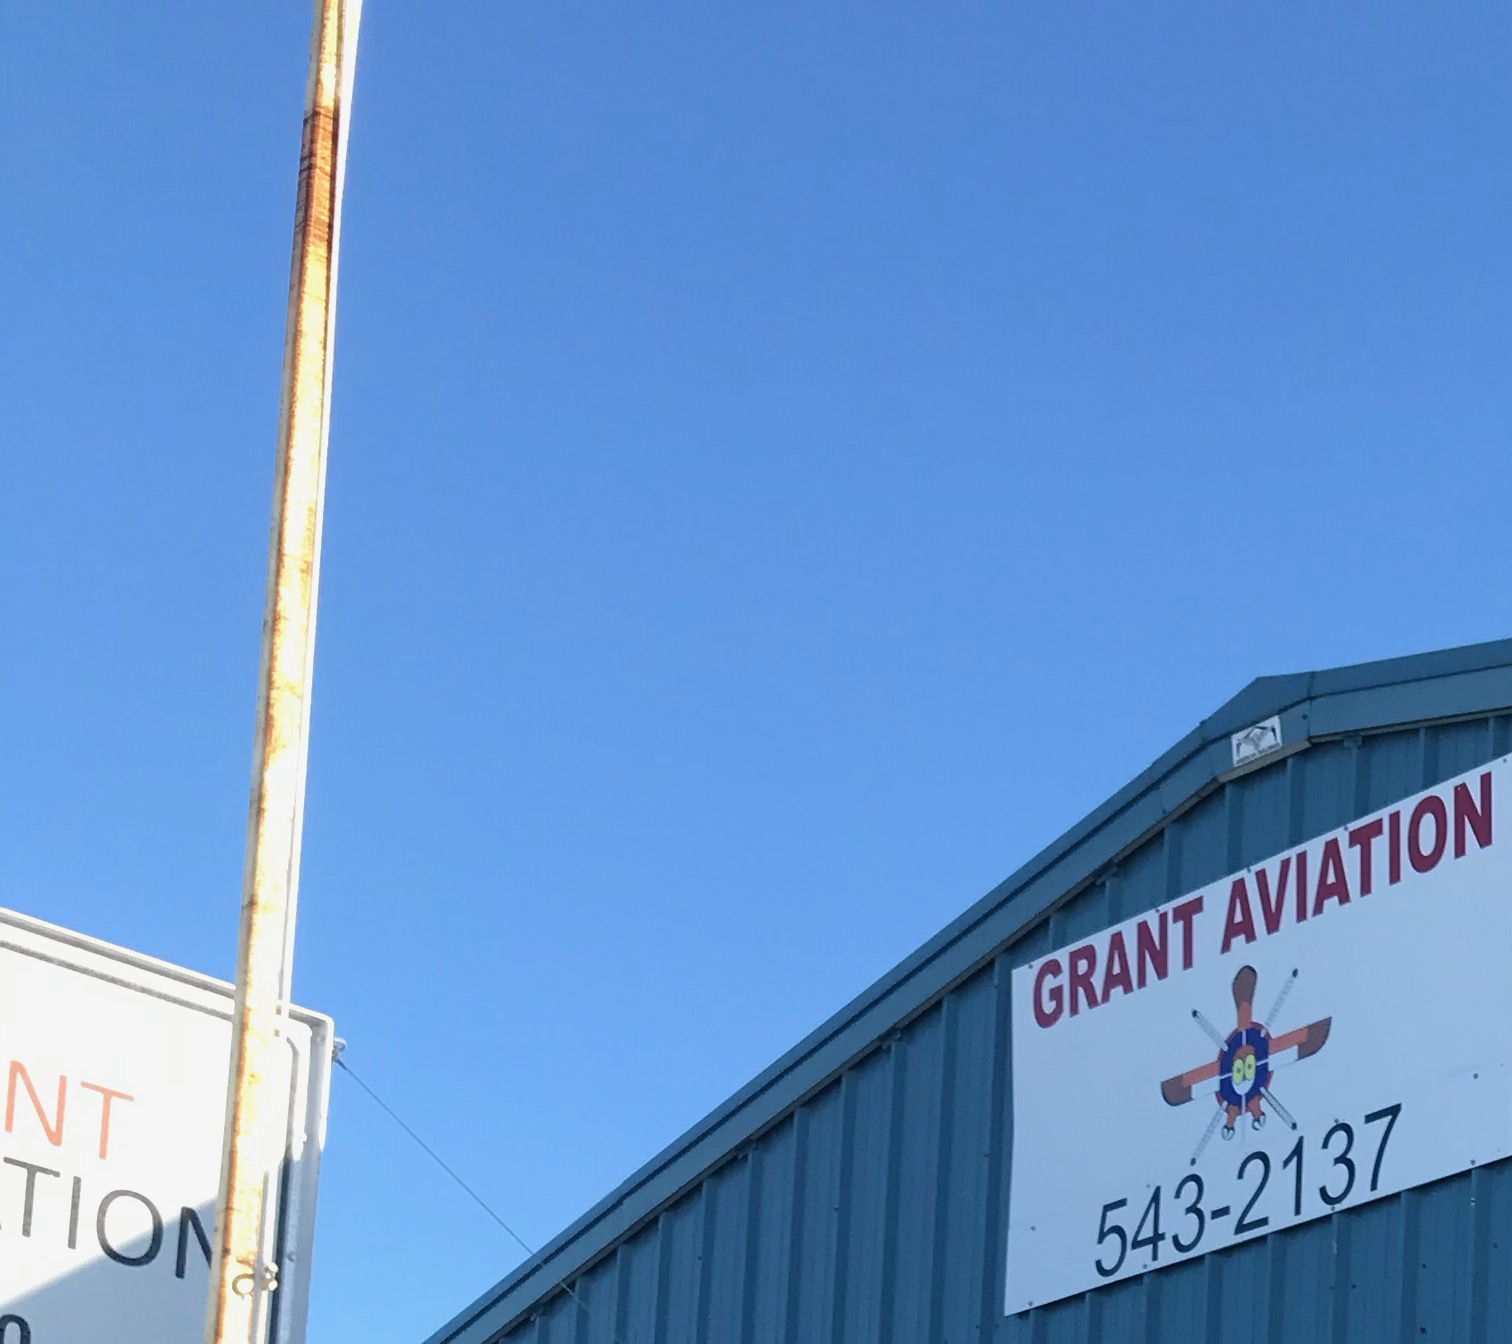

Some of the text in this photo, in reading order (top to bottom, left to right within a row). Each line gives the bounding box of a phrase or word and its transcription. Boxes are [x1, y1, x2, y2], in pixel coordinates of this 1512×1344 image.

[1033, 771, 1493, 1028] GRANT AVIATION
[4, 1060, 135, 1159] NT
[1095, 1103, 1402, 1278] 543-2137
